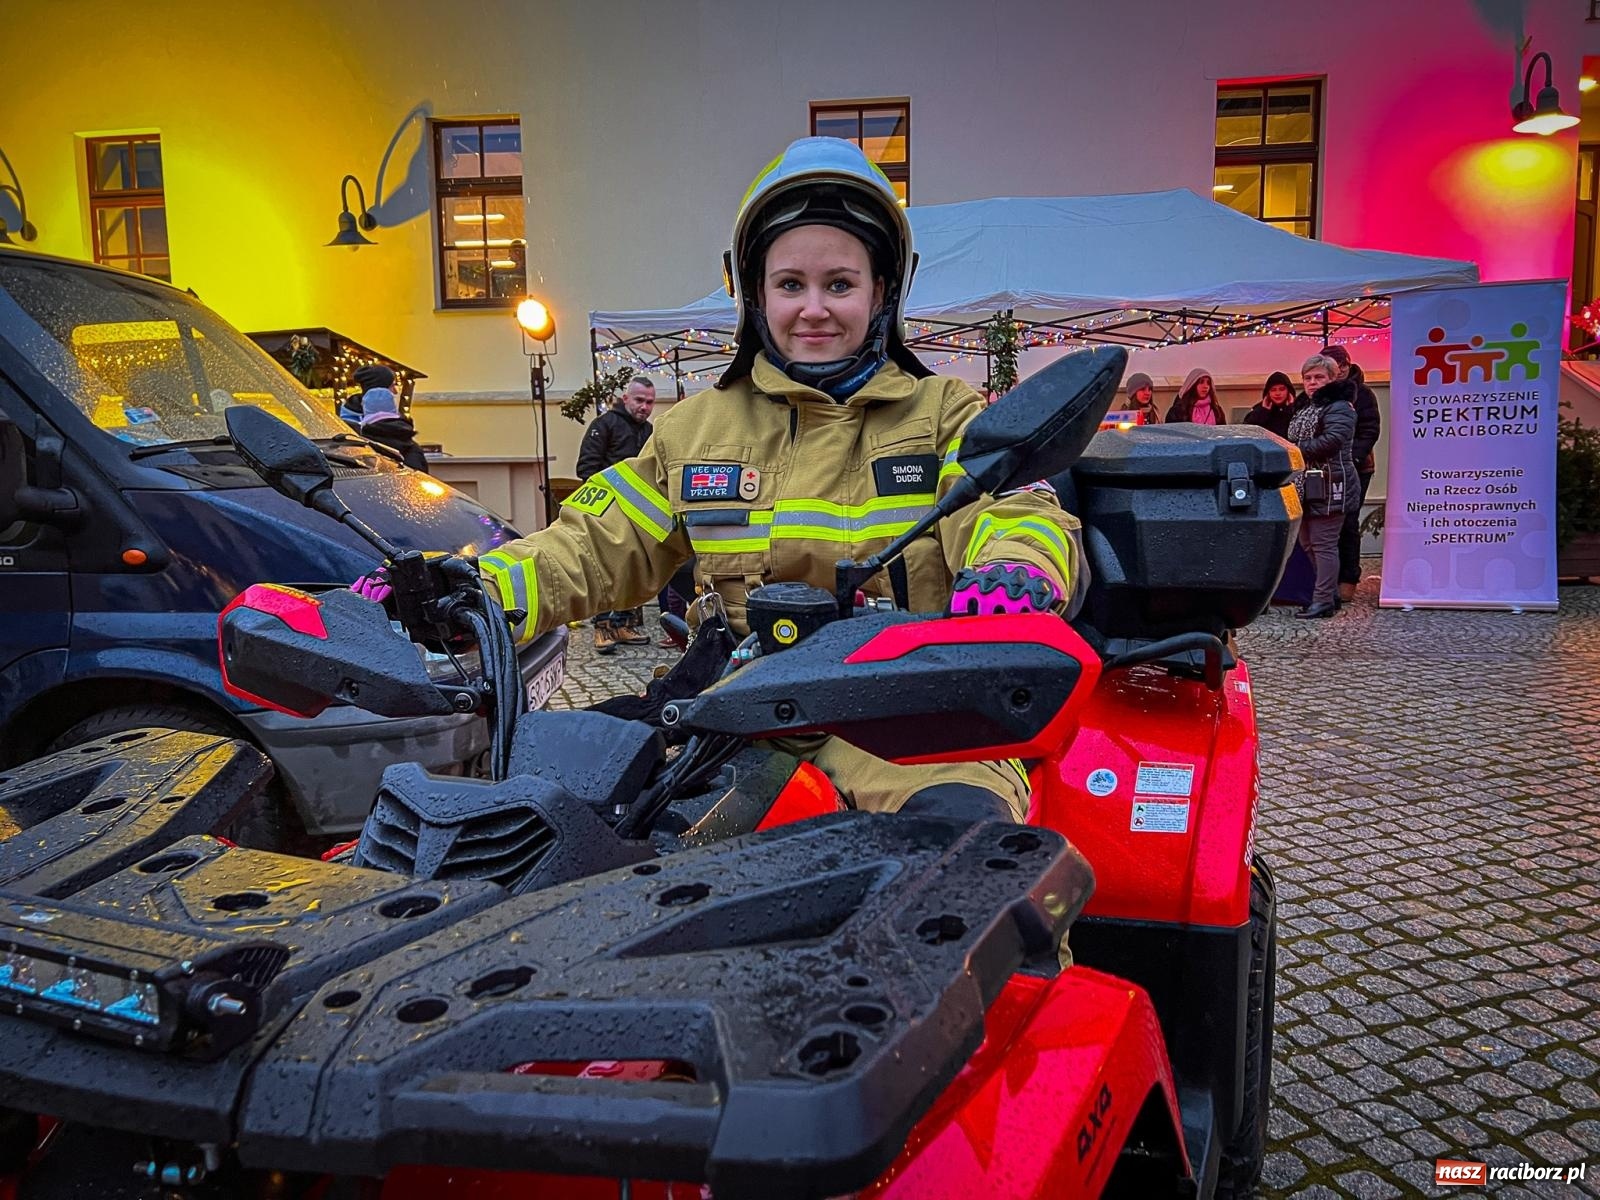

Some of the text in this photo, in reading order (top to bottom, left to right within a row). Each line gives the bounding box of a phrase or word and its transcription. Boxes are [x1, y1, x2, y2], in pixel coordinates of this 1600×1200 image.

[1413, 391, 1540, 406] STOWARZYSZENIE
[1413, 404, 1538, 424] SPEKTRUM
[1413, 423, 1538, 438] W RACIBORZU
[690, 466, 734, 474] WEE WOO
[892, 465, 924, 474] SIMONA
[1421, 467, 1524, 480] Stowarzyszenie
[895, 474, 922, 483] DUDEK
[690, 488, 728, 497] DRIVER
[1425, 483, 1518, 496] na Rzecz Osób
[1407, 499, 1537, 514] Niepełnosprawnych
[1423, 515, 1517, 528] i Ich otoczenia
